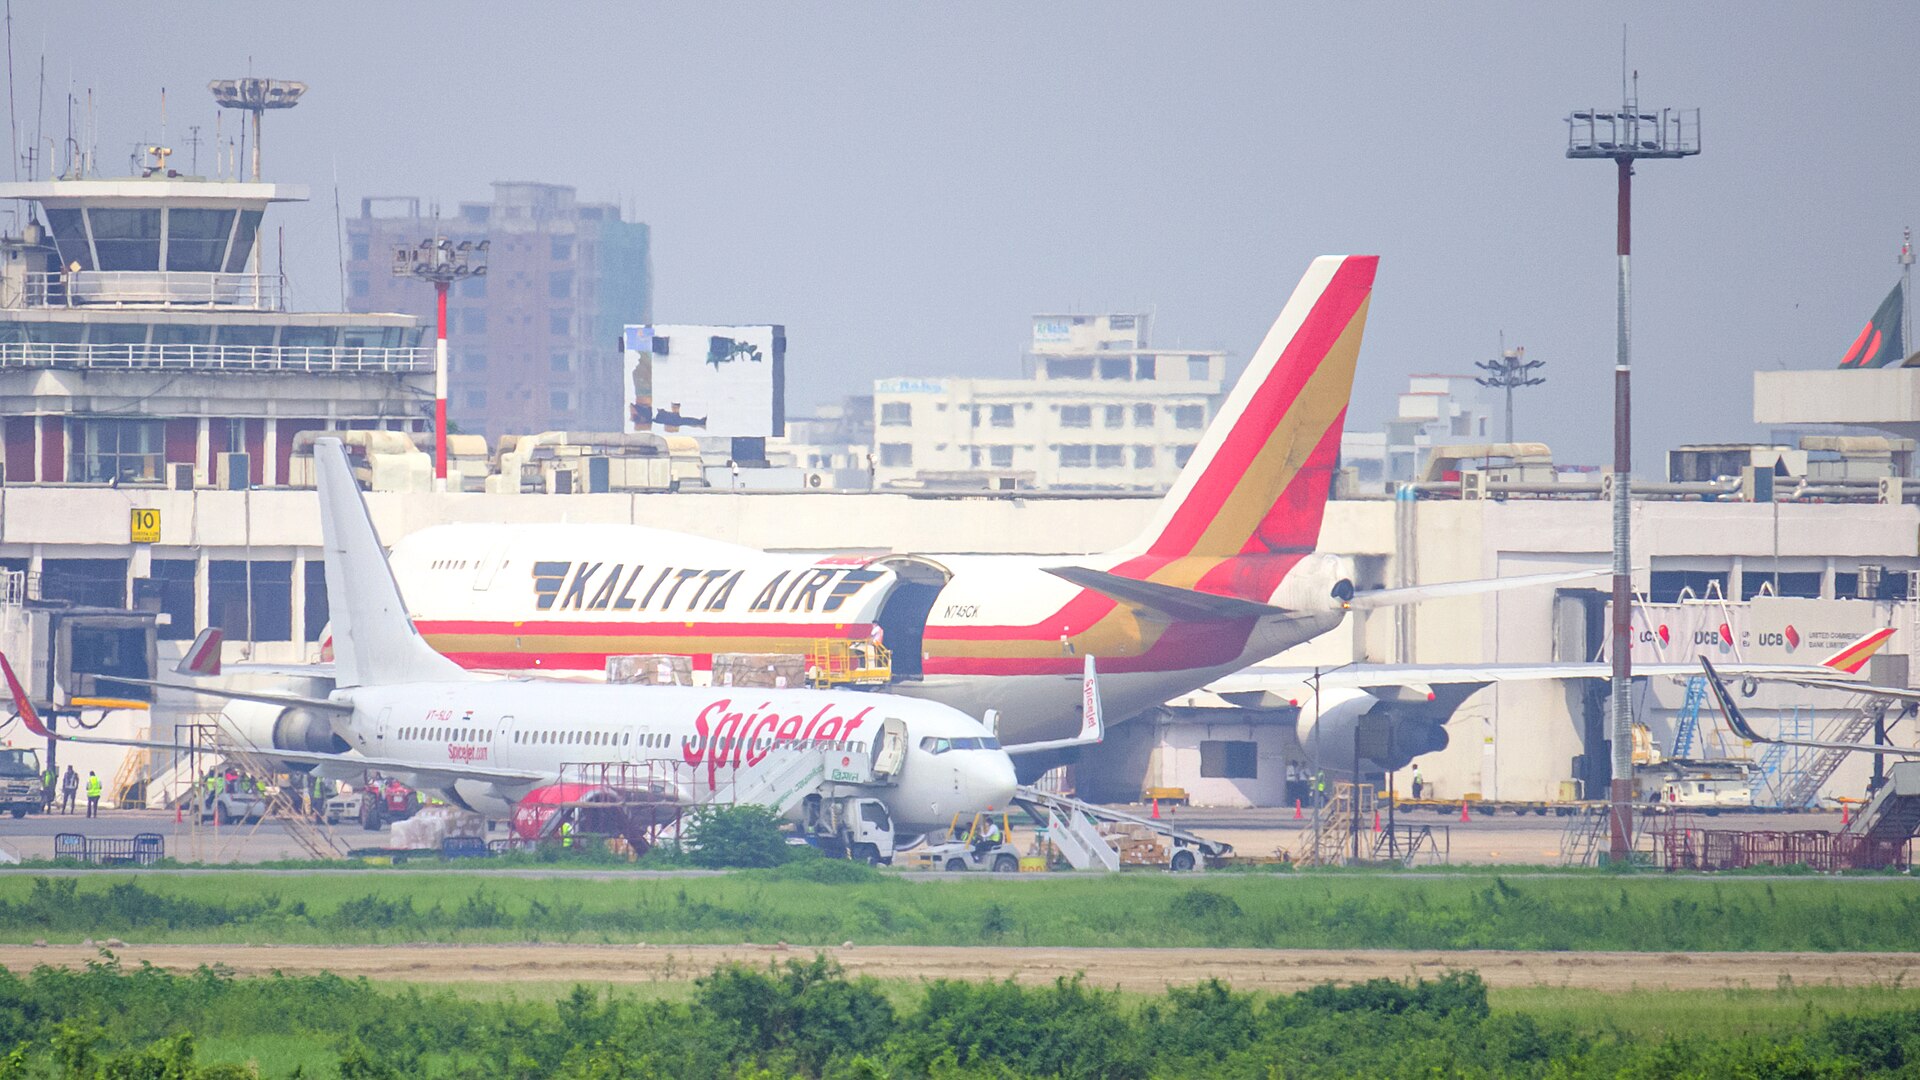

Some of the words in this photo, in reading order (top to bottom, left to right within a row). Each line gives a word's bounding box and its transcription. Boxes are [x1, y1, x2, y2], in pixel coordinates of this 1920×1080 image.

[137, 511, 154, 530] 10
[559, 562, 745, 612] KALITTA
[747, 569, 837, 613] AIR
[1694, 631, 1718, 645] UCB
[1759, 633, 1783, 646] UCB
